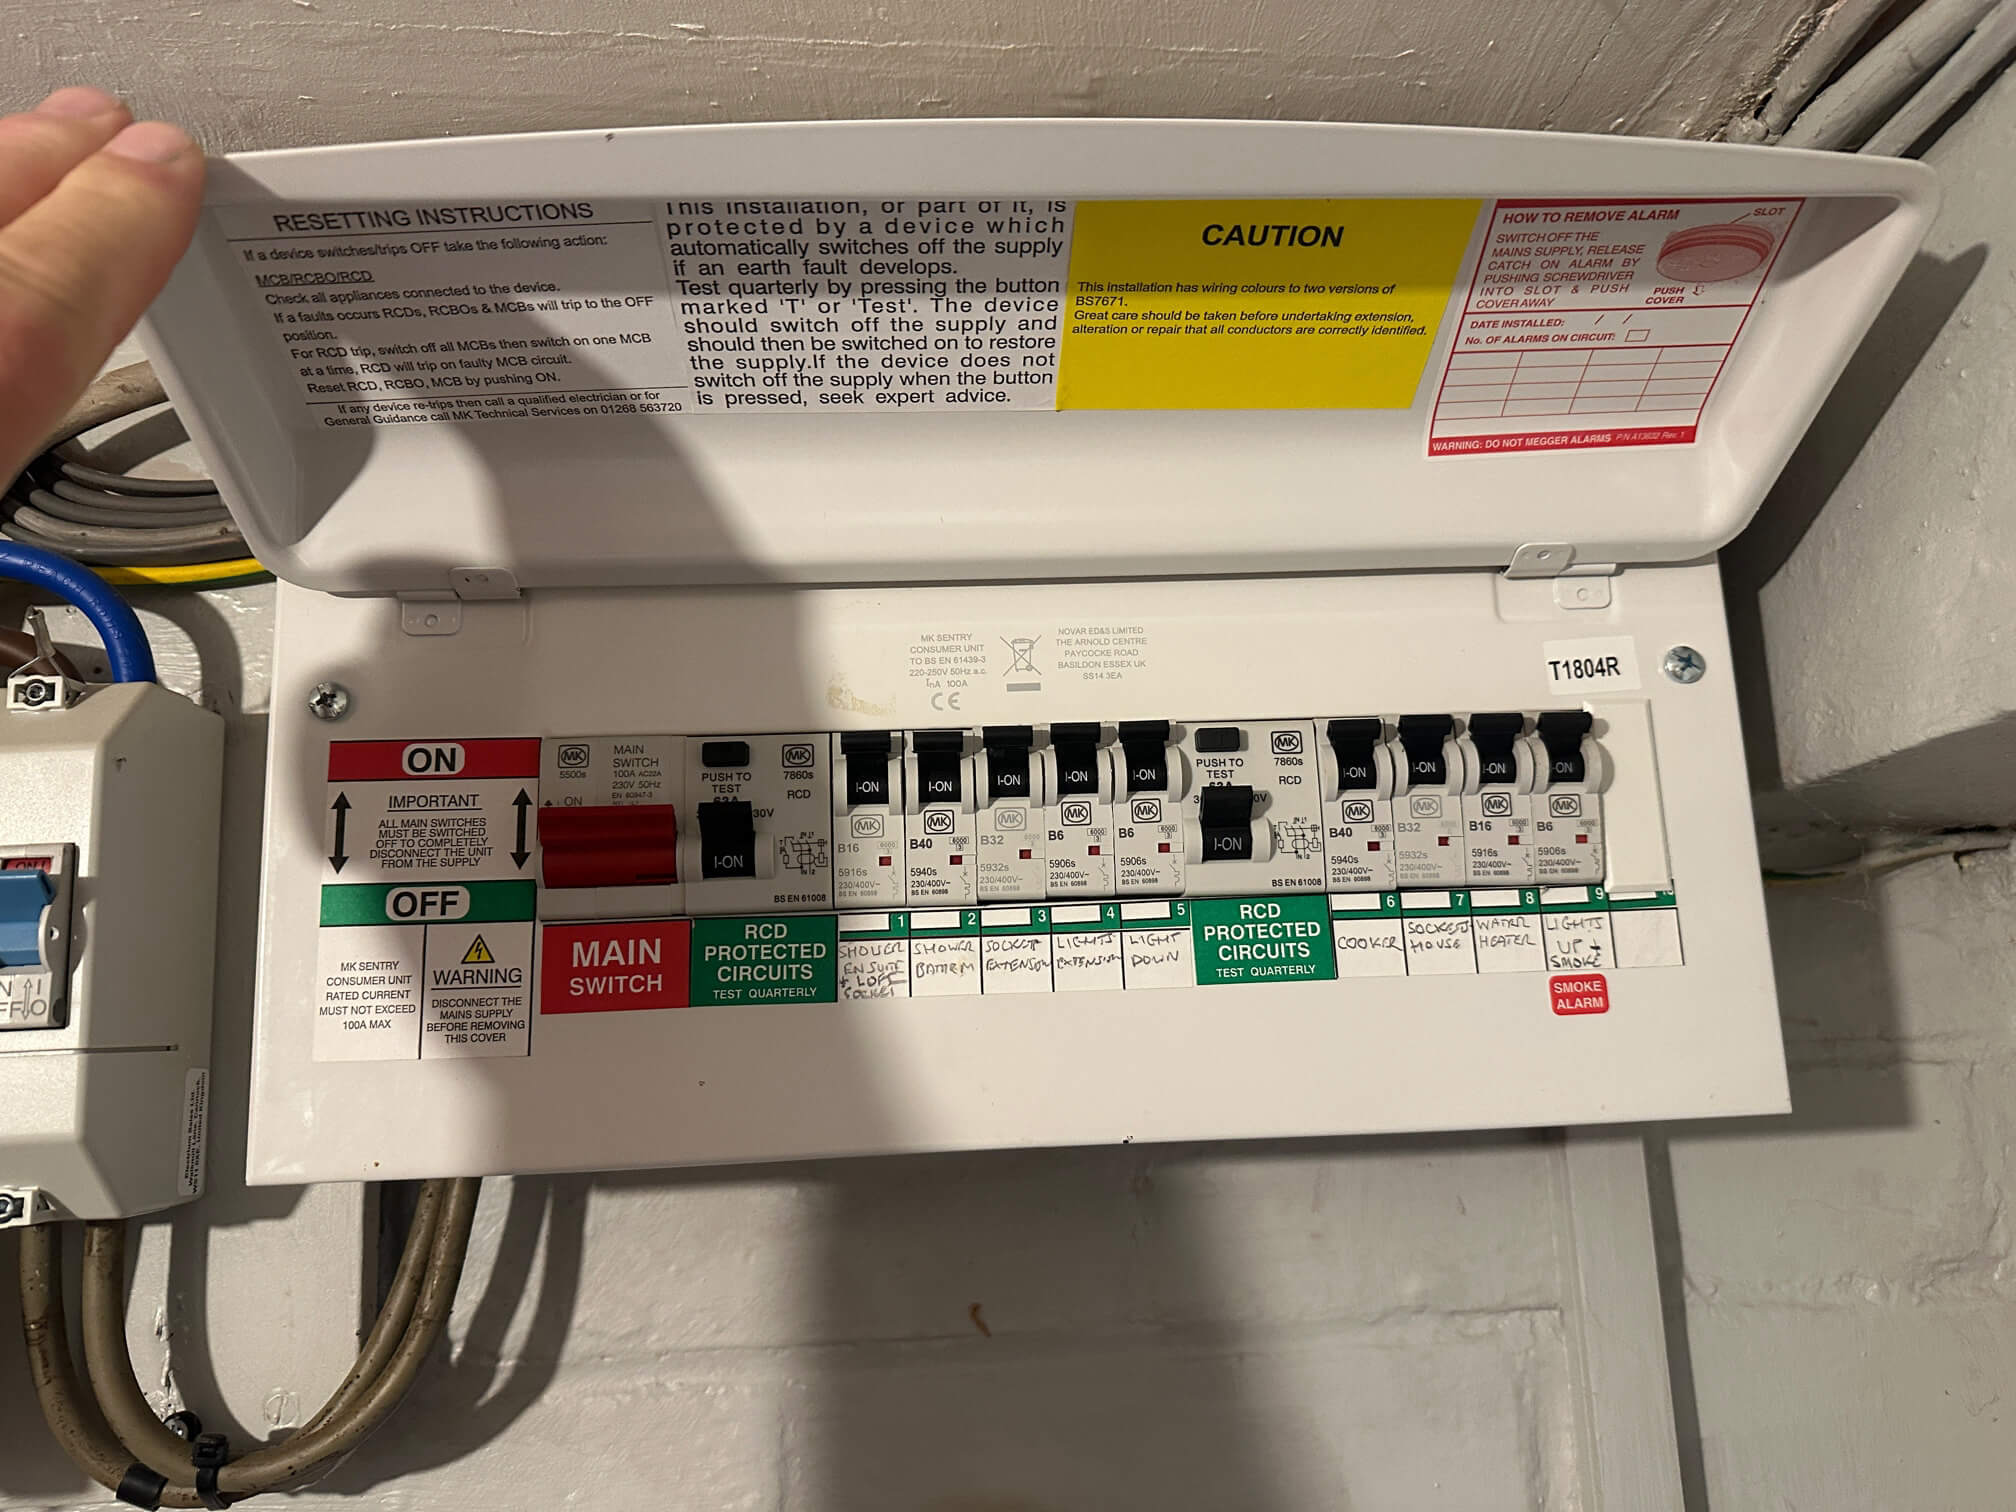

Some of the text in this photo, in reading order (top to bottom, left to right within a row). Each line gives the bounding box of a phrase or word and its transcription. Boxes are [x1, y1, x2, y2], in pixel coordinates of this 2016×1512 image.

[272, 202, 593, 231] RESETTING INSTRUCTIONS
[1502, 209, 1680, 224] HOW TO REMOVE ALARM
[1752, 207, 1786, 216] SLOT
[667, 217, 1064, 239] protected by a device which
[1202, 224, 1344, 247] CAUTION
[258, 252, 267, 260] a
[271, 248, 314, 260] device
[318, 244, 408, 258] switches/trips
[410, 241, 440, 253] OFF
[444, 240, 473, 251] take
[476, 239, 498, 249] the
[501, 238, 560, 249] following
[563, 235, 607, 246] action:
[671, 237, 1063, 259] automatically switches off the supply
[256, 270, 373, 286] MCB/RCBO/RCD
[674, 277, 1059, 298] Test quarterly by pressing the button
[1078, 282, 1396, 294] This installation has wiring colours to two versions of
[1653, 286, 1685, 294] PUSH
[1076, 296, 1128, 306] BS7671.
[1645, 296, 1684, 304] COVER
[1469, 318, 1565, 329] DATE INSTALLED:
[324, 402, 682, 426] General Guidance call MK Technical Services on 01268 563720
[1432, 433, 1611, 450] WARNING: DO NOT MEGGER ALARMS
[920, 632, 972, 642] MK SENTRY
[1055, 637, 1146, 646] THE ARNOLD CENTRE
[909, 643, 984, 653] CONSUMER UNIT
[1548, 656, 1620, 680] T1804R
[1105, 671, 1122, 679] 3EA
[613, 744, 644, 754] MAIN
[405, 747, 456, 773] ON
[562, 751, 585, 762] MK
[612, 757, 658, 768] SWITCH
[701, 771, 751, 782] PUSH TO
[783, 770, 814, 780] 7860s
[711, 783, 741, 793] TEST
[786, 789, 810, 799] RCD
[388, 793, 479, 808] IMPORTANT
[1067, 809, 1086, 818] MK
[377, 817, 486, 828] ALL MAIN SWITCHES
[1468, 820, 1491, 831] B16
[1048, 830, 1064, 840] B6
[1118, 827, 1134, 838] B6
[1328, 827, 1352, 838] B40
[909, 838, 932, 849] B40
[1049, 858, 1075, 868] 5906s
[910, 867, 937, 876] 5940s
[1525, 892, 1535, 905] 8
[1595, 887, 1604, 900] 9
[392, 890, 459, 917] OFF
[1386, 896, 1395, 908] 6
[1455, 894, 1464, 907] 7
[1106, 906, 1115, 919] 4
[1176, 902, 1186, 916] 5
[1239, 903, 1280, 919] RCD
[897, 915, 905, 928] 1
[967, 912, 976, 925] 2
[1037, 910, 1047, 923] 3
[1476, 917, 1531, 930] WATER
[745, 923, 787, 939] RCD
[1203, 921, 1320, 941] PROTECTED
[913, 940, 975, 954] SHOWER
[1337, 936, 1403, 952] COOKER
[1410, 939, 1462, 953] HOUSE
[1479, 934, 1537, 948] HEATER
[1557, 938, 1583, 954] UP
[572, 937, 660, 967] MAIN
[704, 942, 826, 961] PROTECTED
[1218, 941, 1310, 960] CIRCUITS
[1131, 951, 1180, 968] DOWN
[1550, 954, 1602, 968] SMOKE
[432, 967, 522, 985] WARNING
[717, 963, 812, 982] CIRCUITS
[1215, 964, 1315, 977] TEST QUARTERLY
[569, 973, 662, 995] SWITCH
[1553, 980, 1602, 993] SMOKE
[712, 986, 816, 999] TEST QUARTERLY
[1556, 996, 1603, 1009] ALARM
[343, 1018, 391, 1029] 100A MAX
